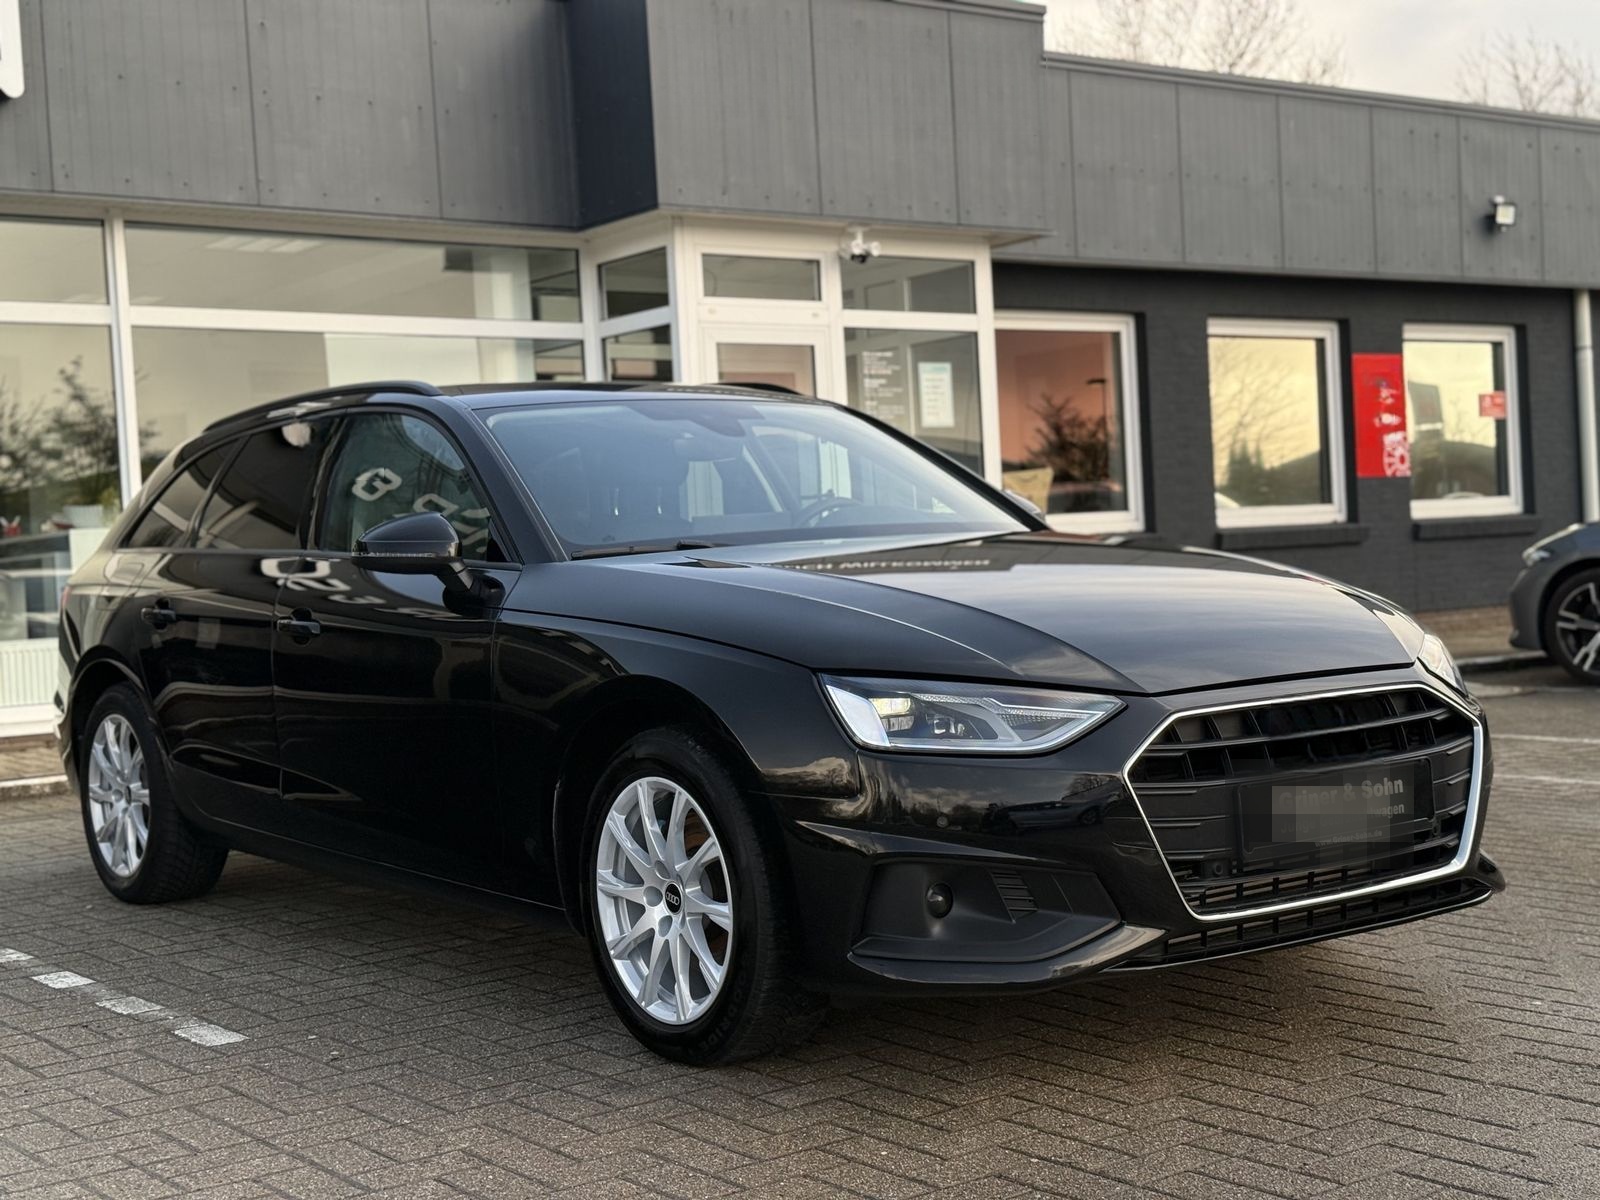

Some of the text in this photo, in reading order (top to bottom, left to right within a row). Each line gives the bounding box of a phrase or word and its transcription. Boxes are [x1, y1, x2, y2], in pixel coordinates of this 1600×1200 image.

[1279, 777, 1404, 809] Griner & Sohn
